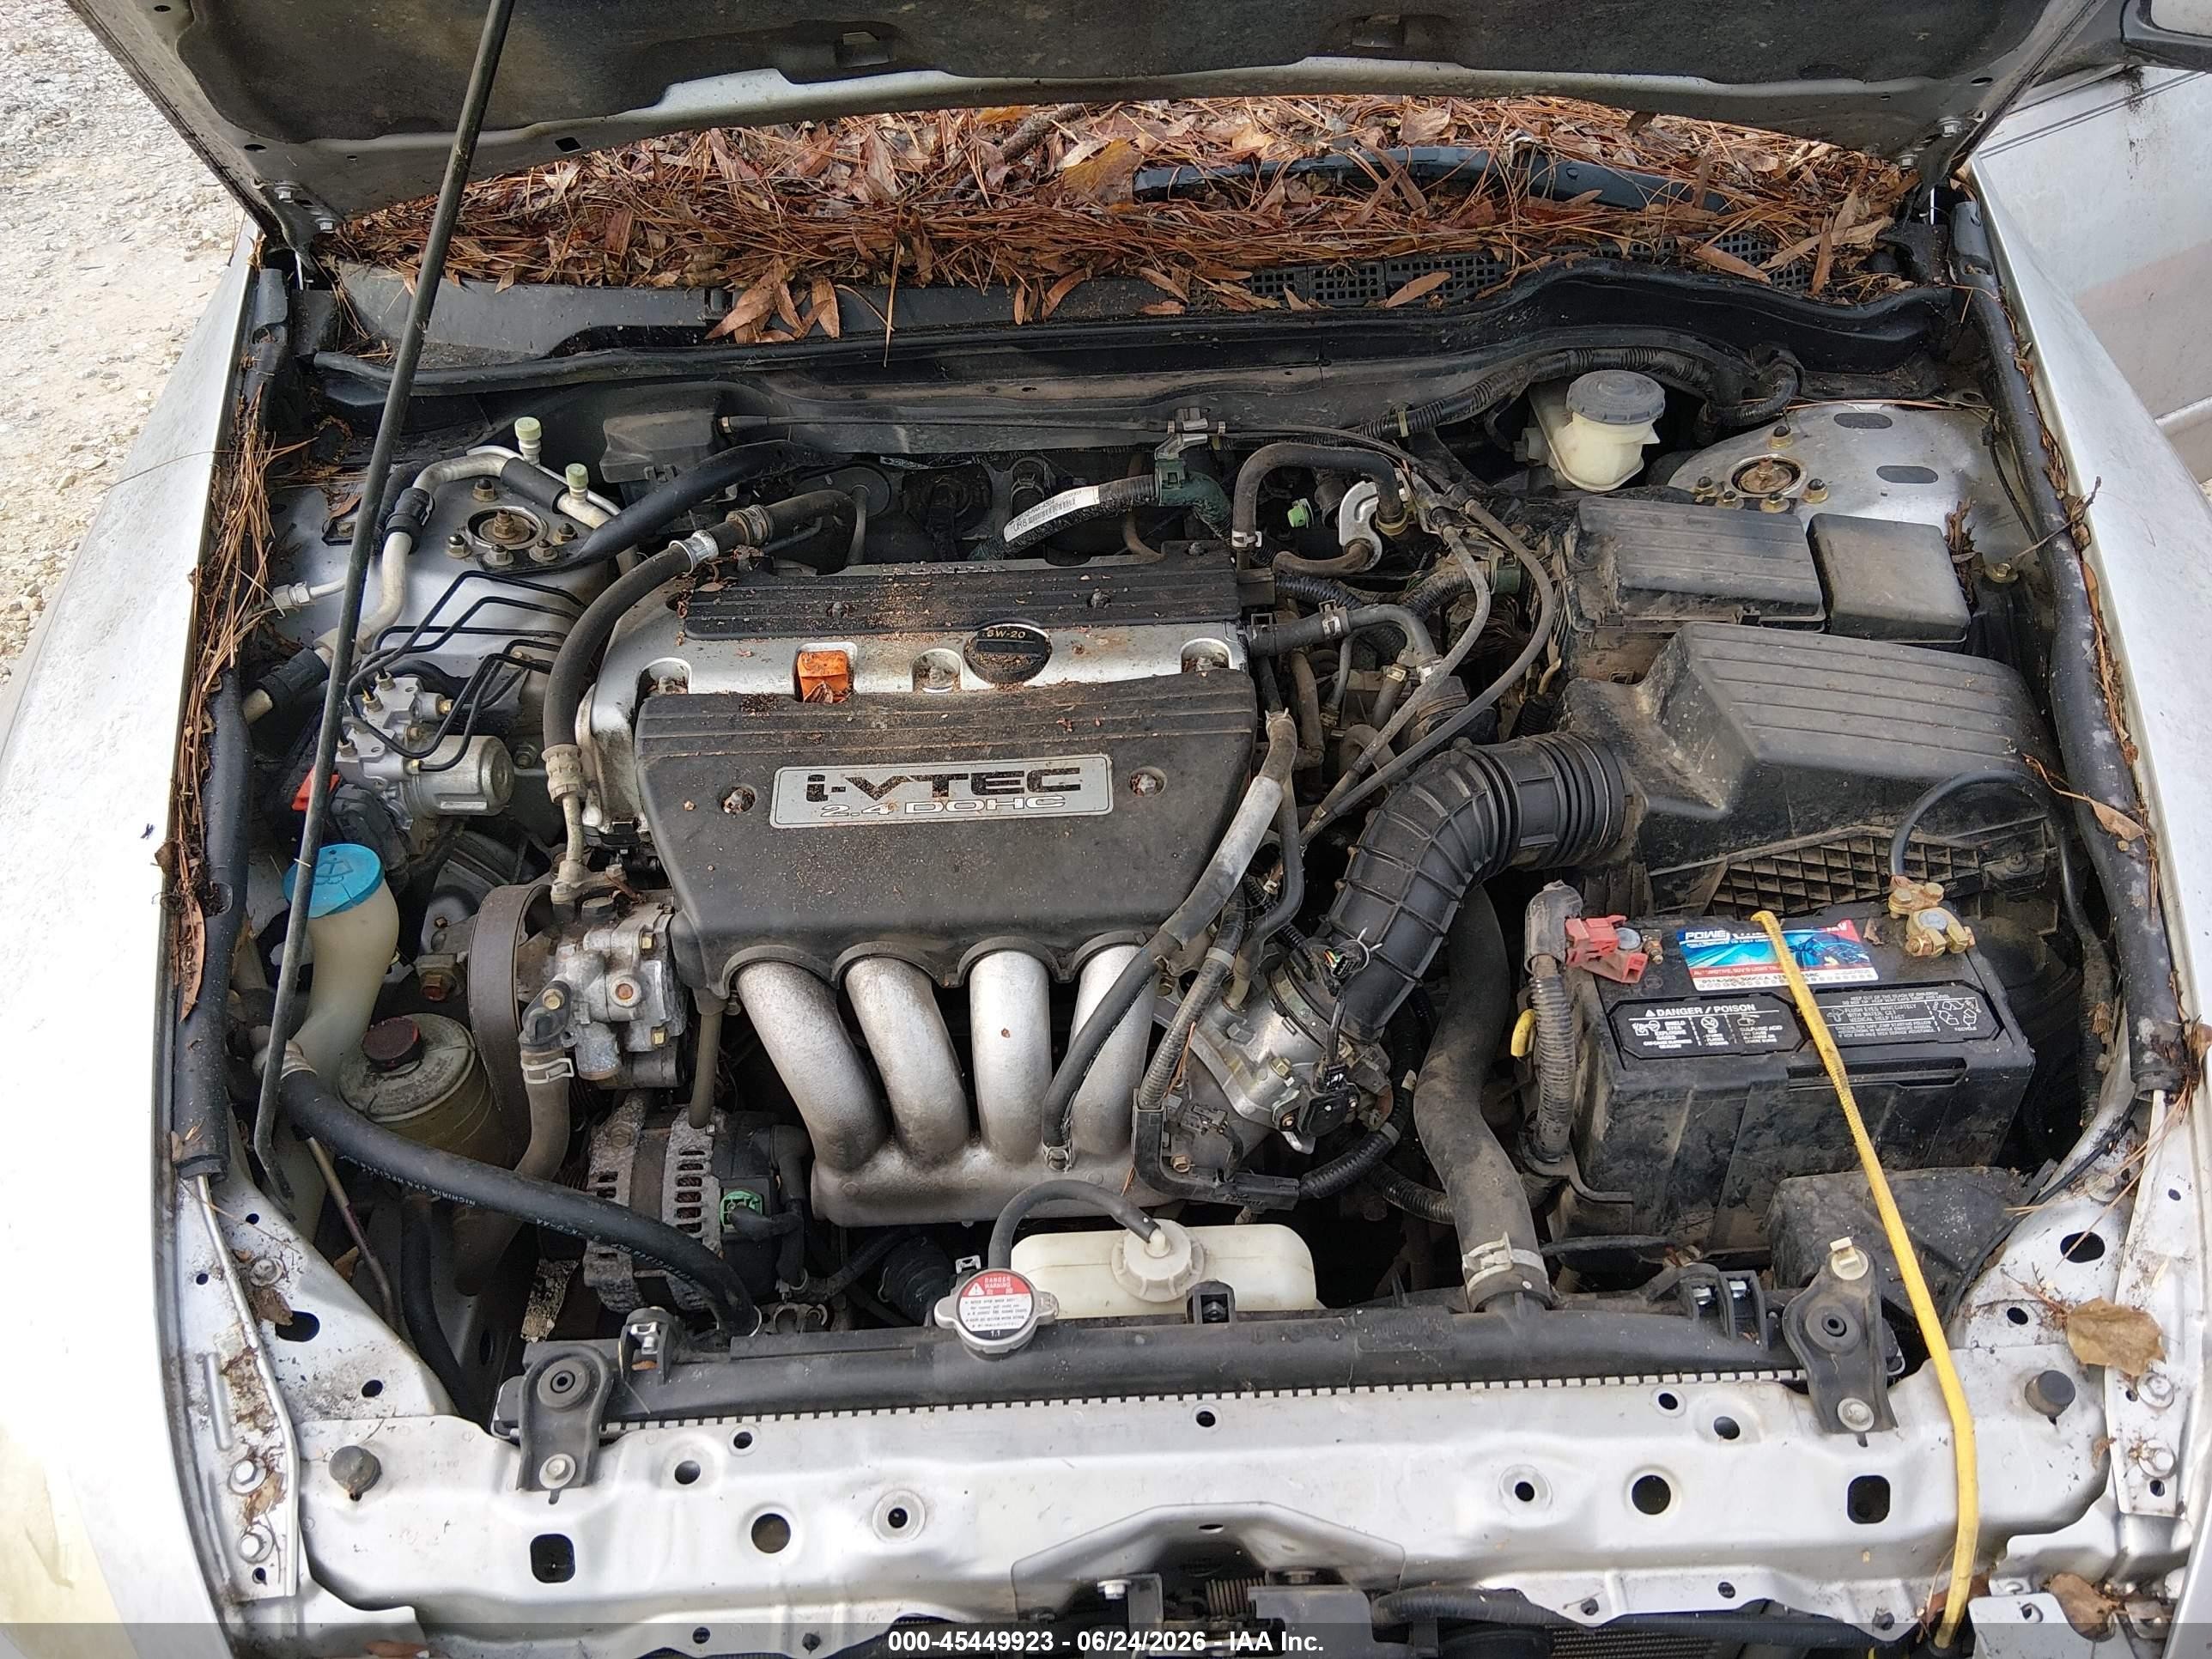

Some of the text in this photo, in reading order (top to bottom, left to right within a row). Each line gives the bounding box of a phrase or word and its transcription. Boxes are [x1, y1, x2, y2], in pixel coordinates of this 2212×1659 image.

[805, 767, 1081, 802] i-VTEC
[820, 795, 1066, 817] 2.4 DOHC
[1656, 1003, 1757, 1017] DANGER / POISON
